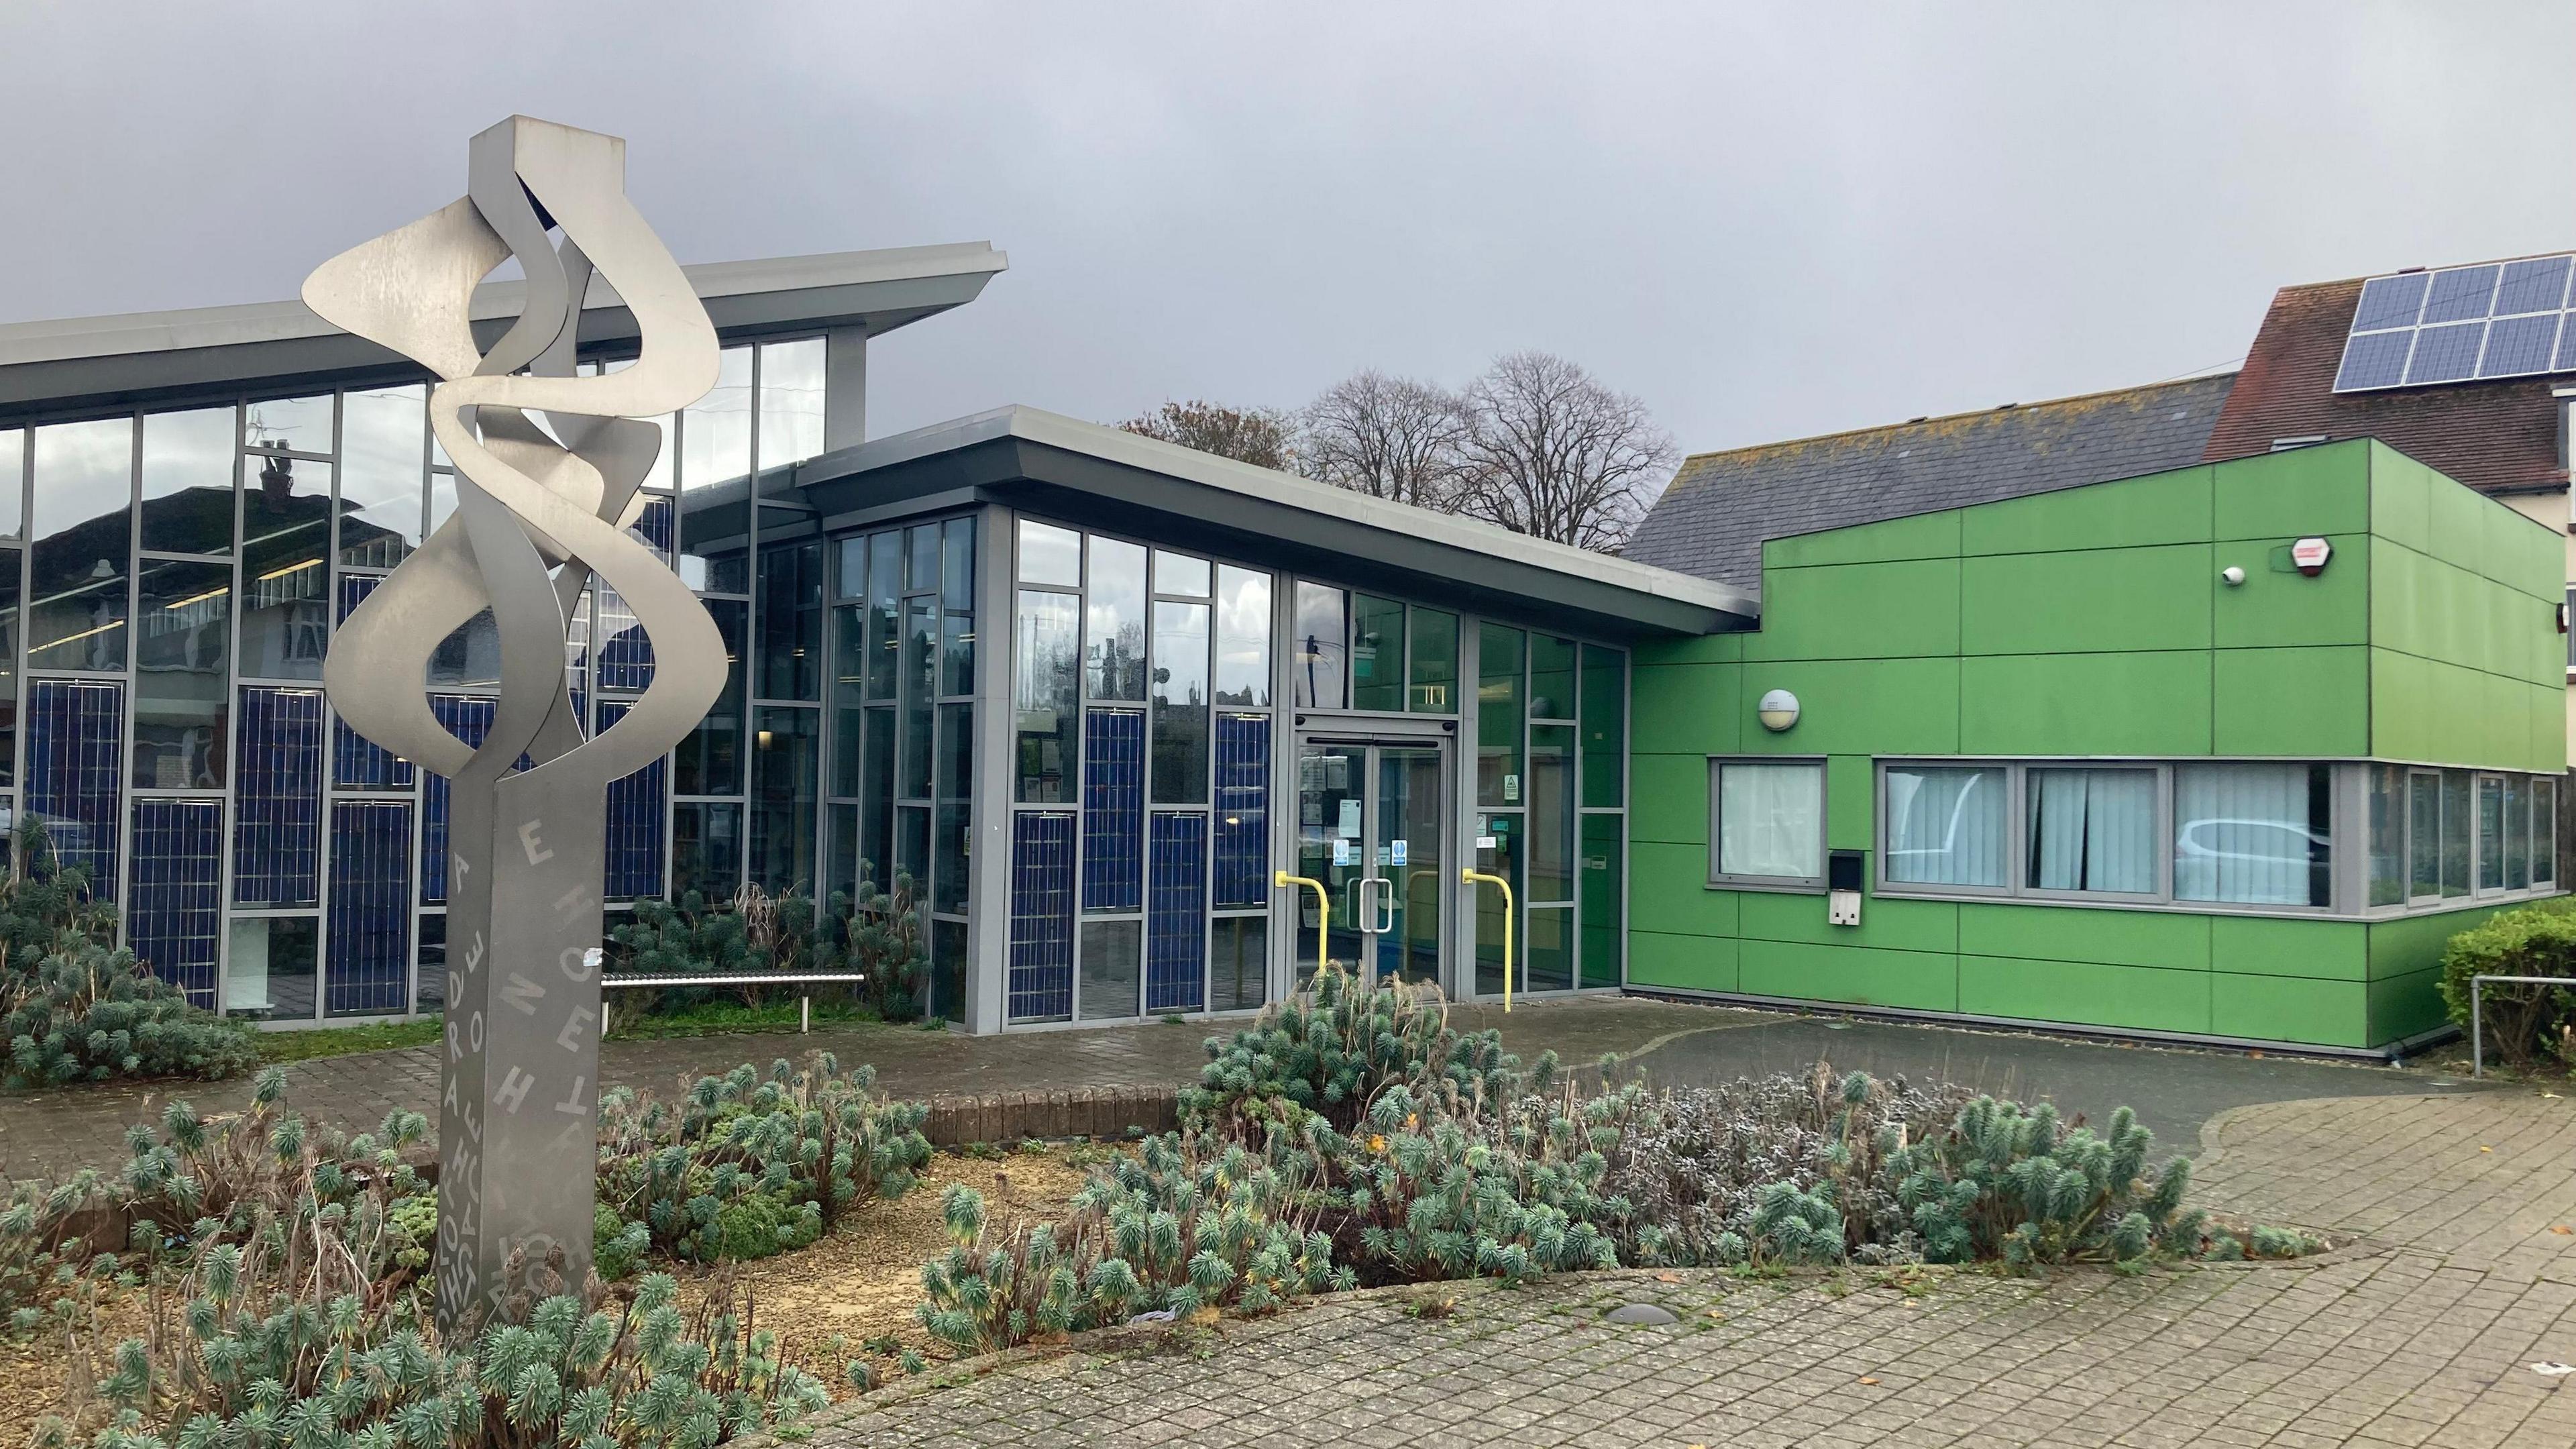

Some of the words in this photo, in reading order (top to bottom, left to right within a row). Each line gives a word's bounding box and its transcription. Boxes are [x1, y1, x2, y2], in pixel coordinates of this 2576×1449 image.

[517, 818, 554, 866] E
[453, 851, 470, 896] A
[449, 971, 462, 1011] D
[447, 1021, 463, 1064] R
[470, 1010, 483, 1053] O
[555, 1004, 596, 1053] E
[444, 1073, 458, 1117] A
[492, 1065, 535, 1115] H
[554, 1075, 588, 1116] T
[464, 1099, 482, 1143] E
[463, 1263, 477, 1309] T
